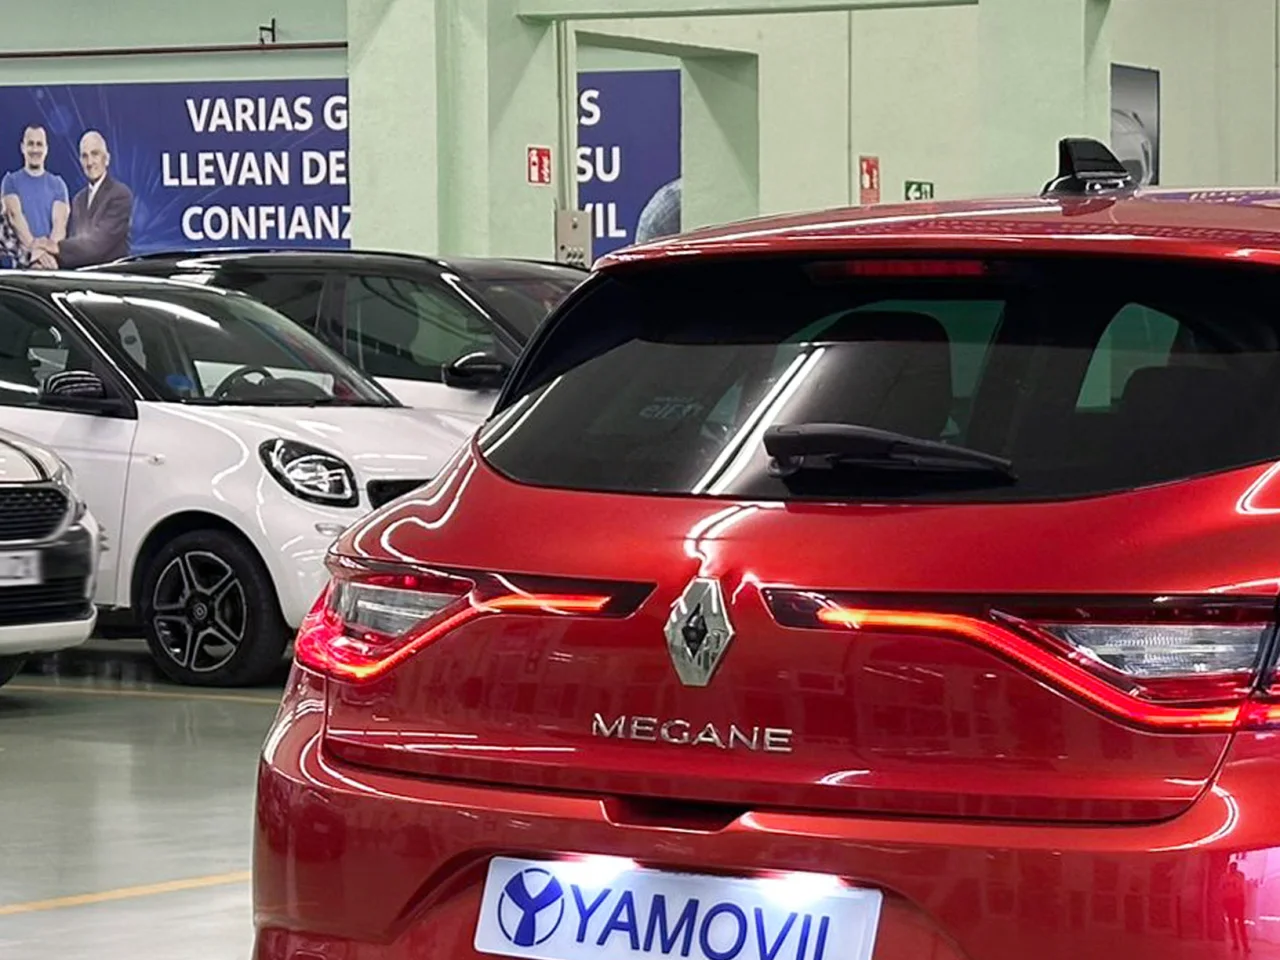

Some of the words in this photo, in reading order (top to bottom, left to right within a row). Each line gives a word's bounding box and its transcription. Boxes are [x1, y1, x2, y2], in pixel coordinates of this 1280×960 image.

[186, 96, 314, 132] VARIAS
[162, 150, 290, 187] LLEVAN
[577, 145, 620, 183] SU
[584, 203, 627, 238] IL
[591, 712, 794, 753] MEGANE
